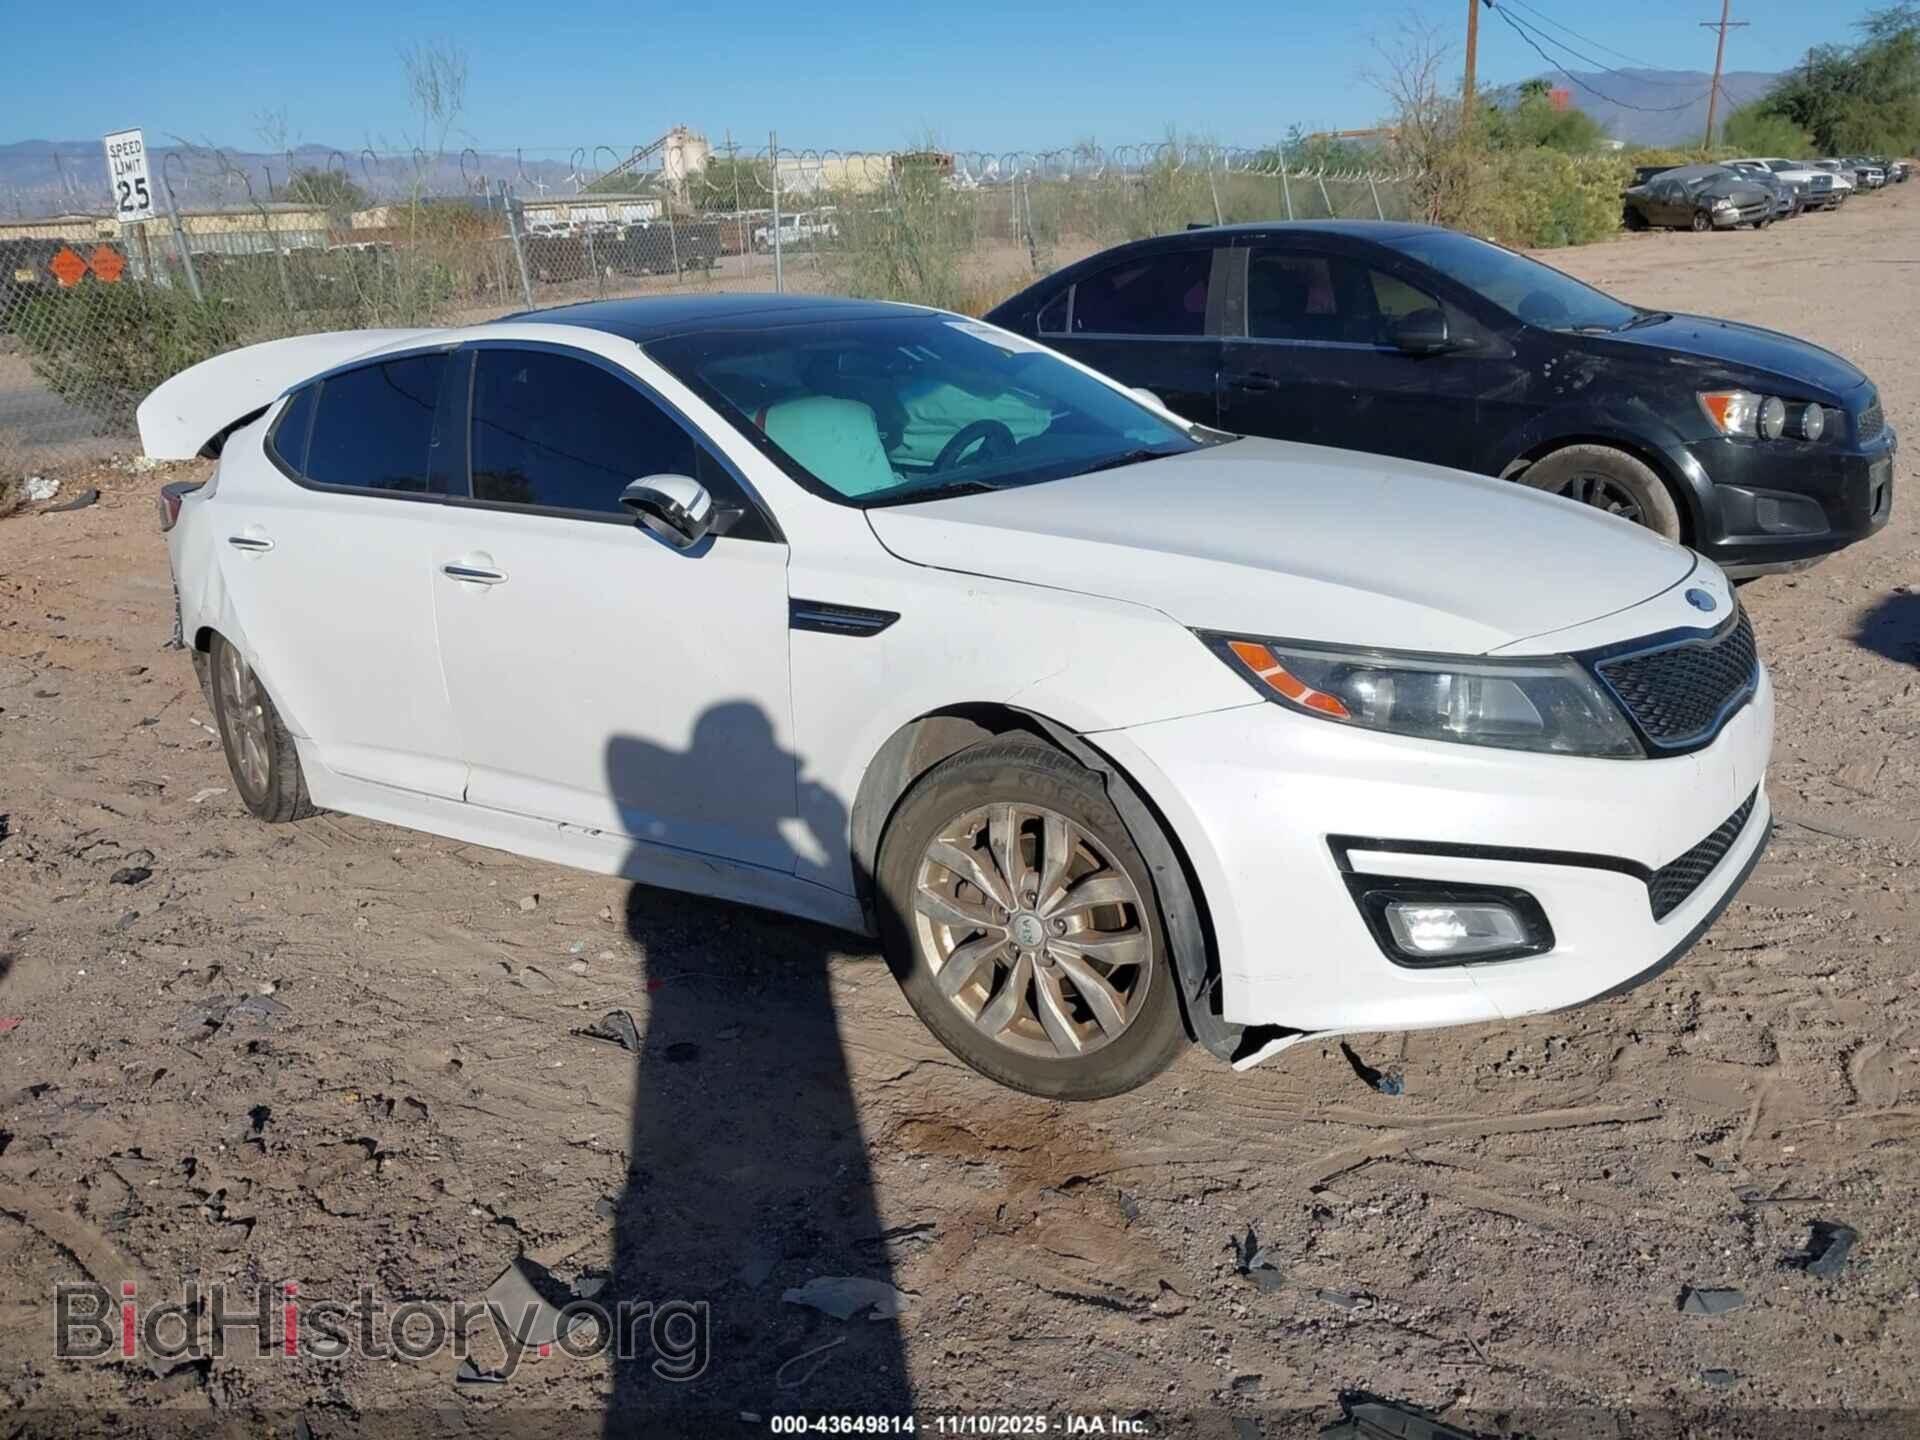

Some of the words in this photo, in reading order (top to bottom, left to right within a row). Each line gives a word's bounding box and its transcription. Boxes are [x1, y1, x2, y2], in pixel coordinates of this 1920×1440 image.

[109, 140, 142, 158] SPEED
[113, 159, 141, 176] LIMIT
[117, 177, 150, 212] 25
